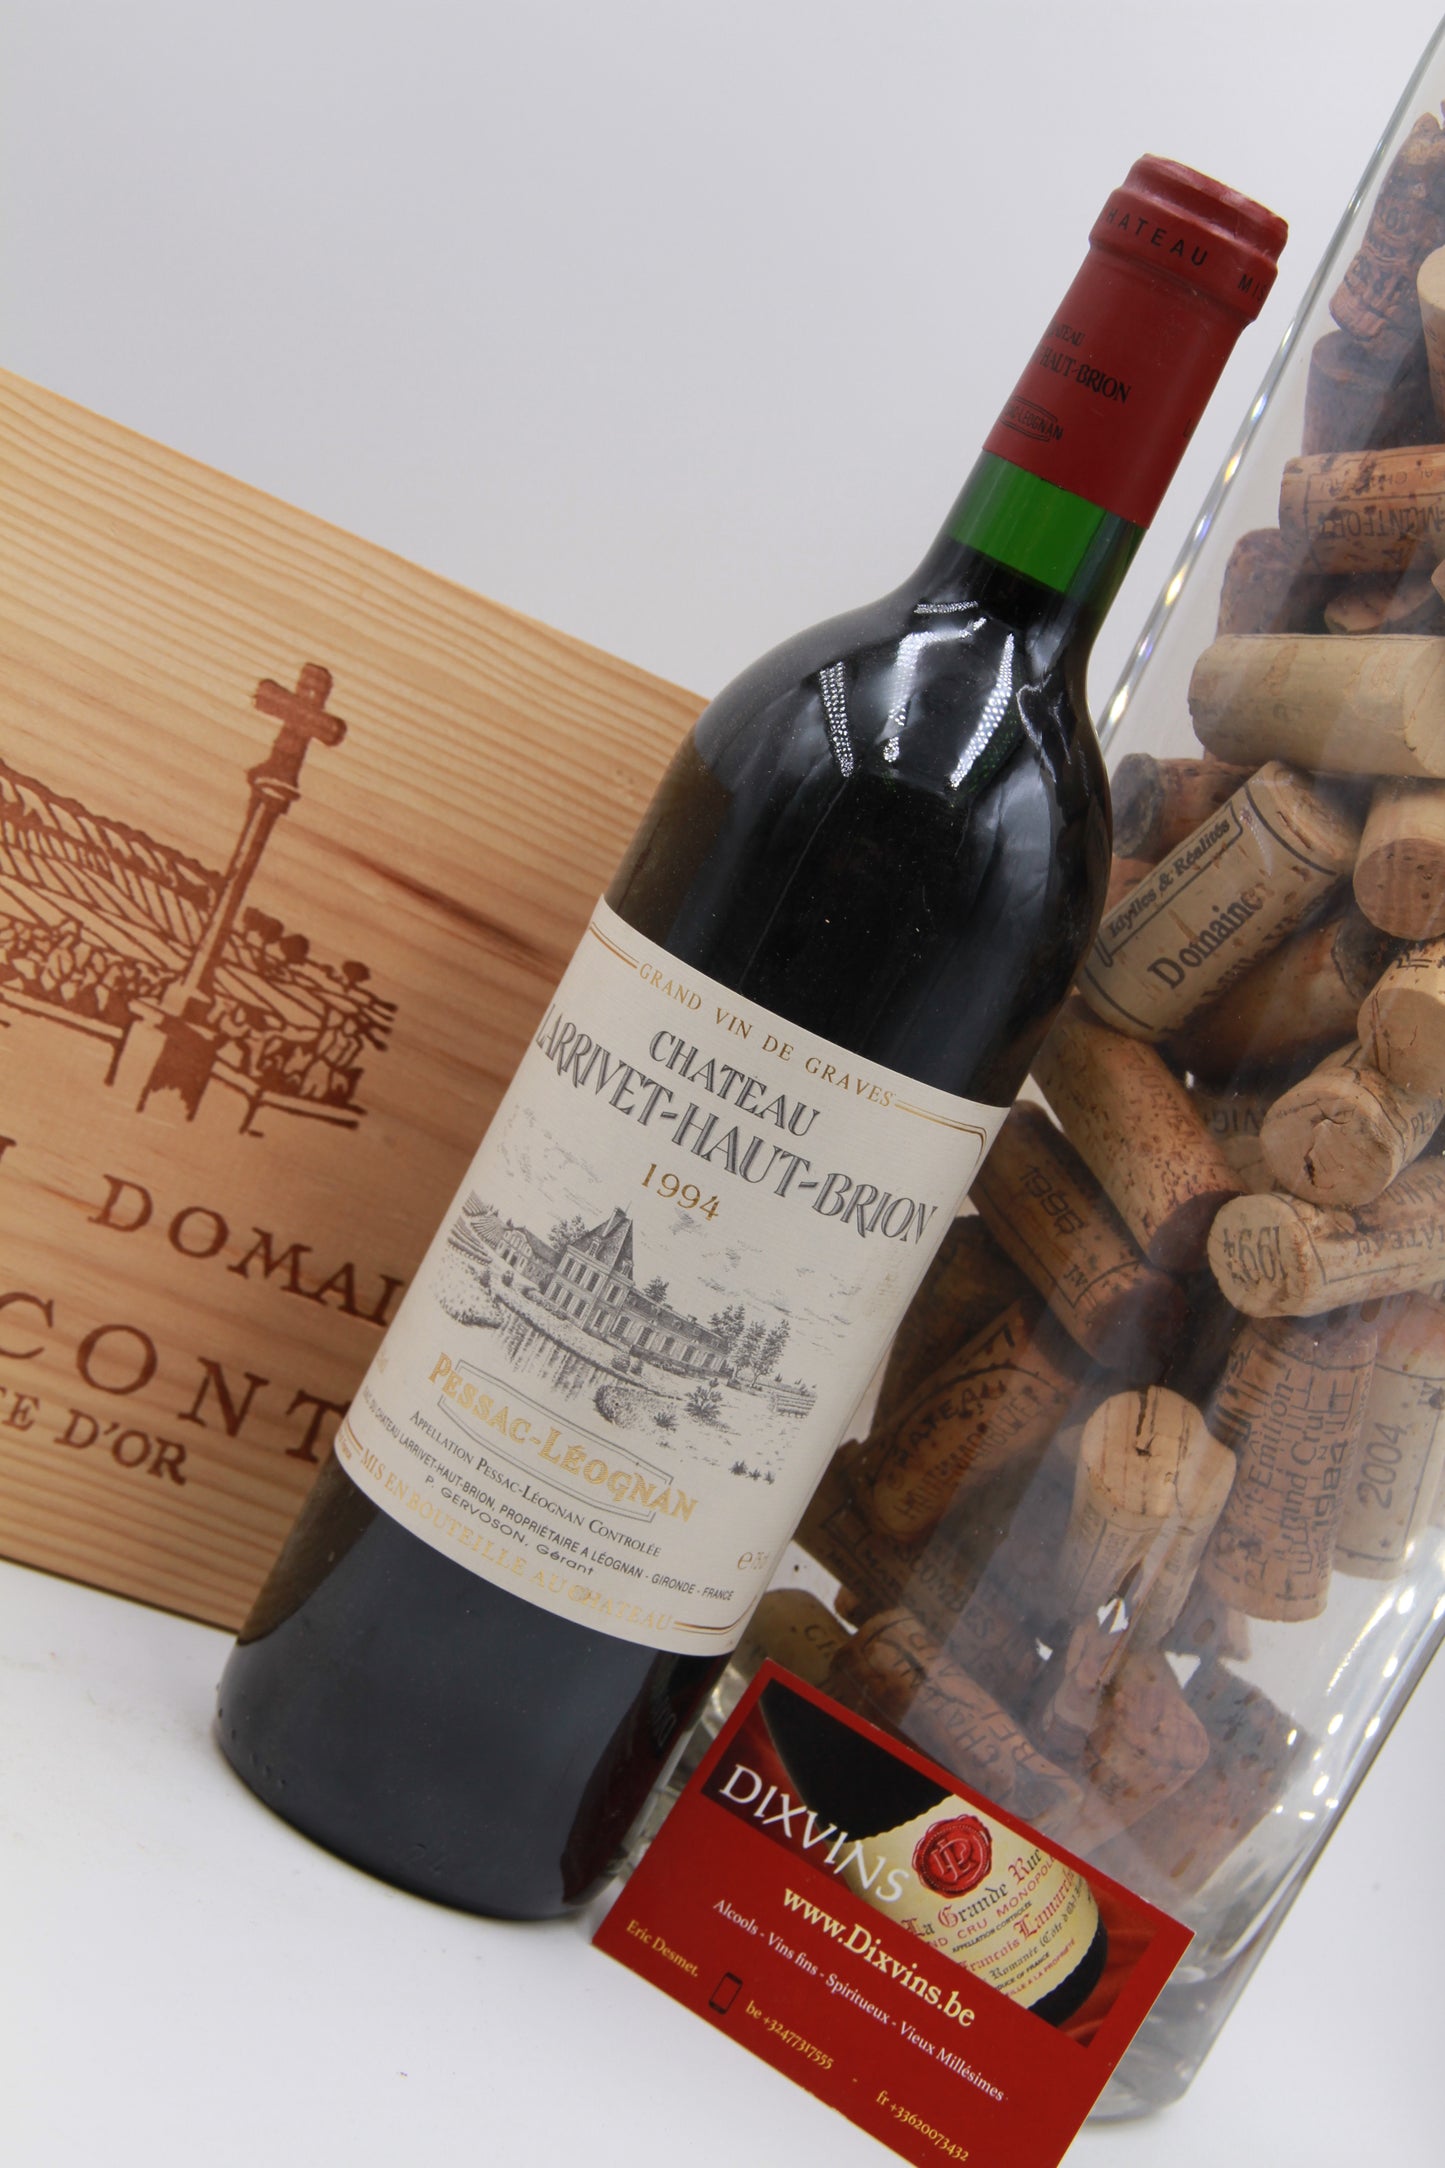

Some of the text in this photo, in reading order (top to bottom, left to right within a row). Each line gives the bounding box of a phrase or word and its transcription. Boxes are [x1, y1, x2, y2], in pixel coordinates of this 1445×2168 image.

[1158, 871, 1175, 892] &
[638, 962, 896, 1108] GRAND VIN DE GRAVES
[648, 1029, 821, 1138] CHATEAU
[536, 1004, 939, 1246] LARRIVET-HAUT-BRION
[640, 1162, 721, 1222] 1994
[87, 1174, 405, 1328] DOMAI
[54, 1407, 188, 1487] D'OR
[409, 1410, 475, 1465] APPELLATION
[475, 1456, 586, 1527] PESSAC-LÉOGNAN
[427, 1351, 699, 1524] PESSAC-LÉOGNAN
[1290, 1410, 1325, 1466] Cru
[1355, 1421, 1407, 1511] 2004
[360, 1448, 674, 1632] MIS EN BOUTEILLE AU CHATEAU
[424, 1474, 435, 1489] P.
[535, 1543, 595, 1576] Gérant
[499, 1504, 581, 1553] PROPRIÉTAIRE
[579, 1547, 590, 1558] A
[590, 1550, 645, 1580] LÉOGNAN
[651, 1573, 697, 1595] GIRONDE
[701, 1586, 735, 1602] FRANCE
[718, 1762, 911, 1905] DIXVINS
[625, 1919, 653, 1945] Eric
[937, 1882, 1009, 1929] Grande
[956, 1917, 989, 1940] CRU
[712, 1898, 1005, 2102] Alcools Vins fins Spiritueux Vieux Millésimes
[782, 1886, 976, 2028] www.Dixvins.be
[1025, 1951, 1050, 1973] FRANCE
[745, 1999, 835, 2071] be +32477317555
[875, 2089, 970, 2163] fr +33620073432
